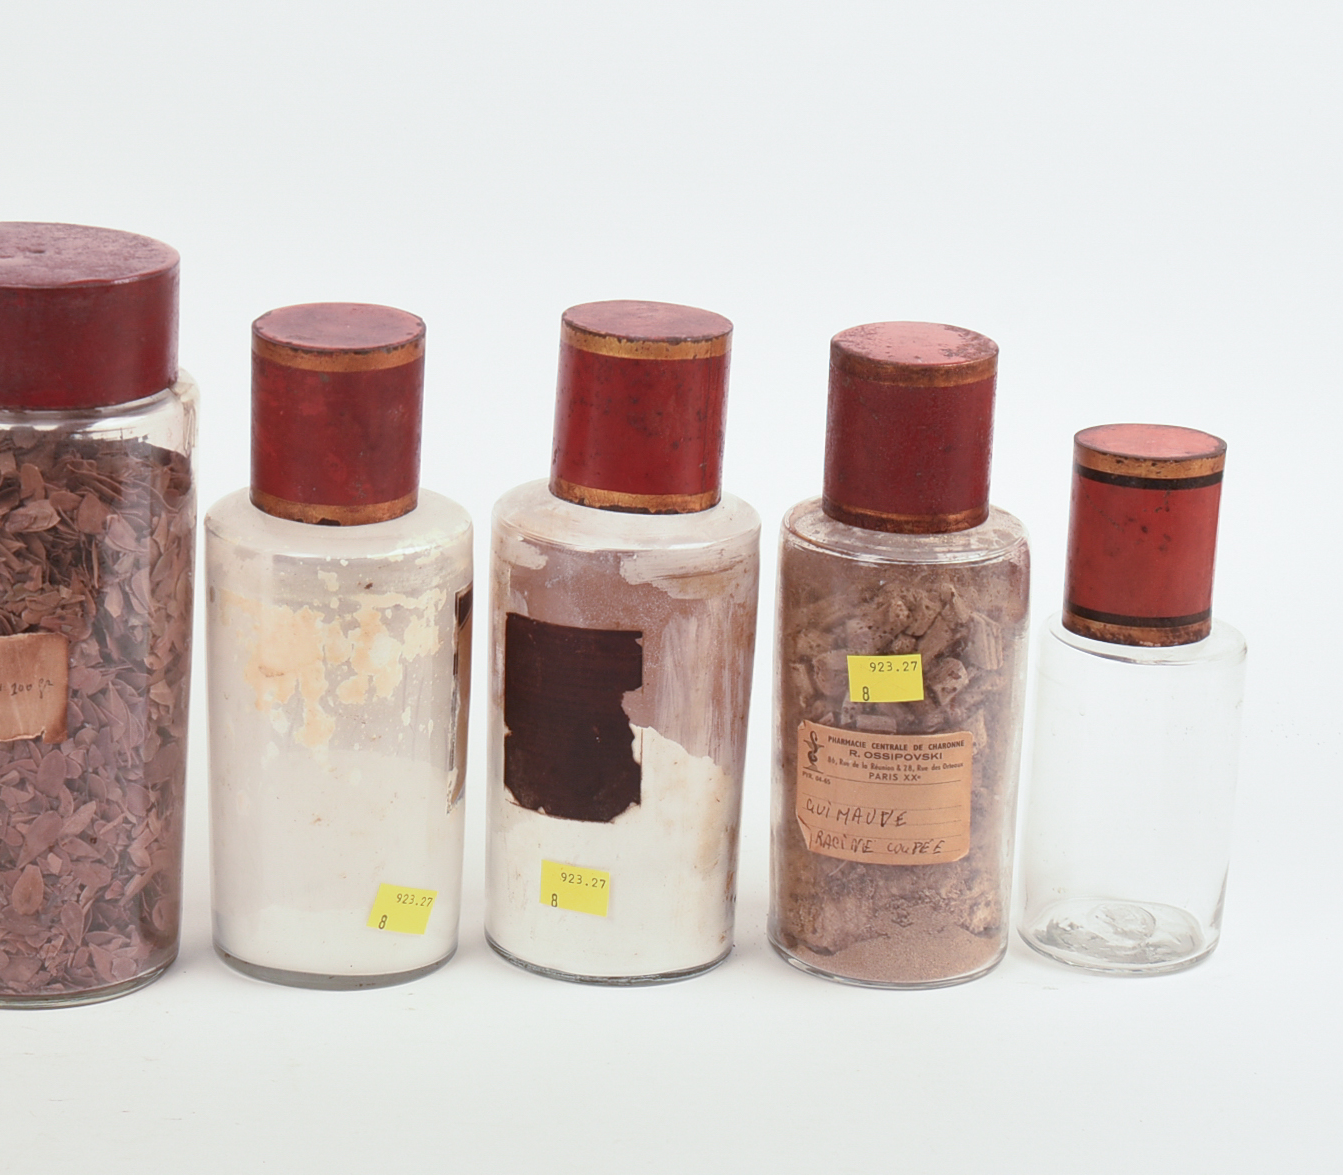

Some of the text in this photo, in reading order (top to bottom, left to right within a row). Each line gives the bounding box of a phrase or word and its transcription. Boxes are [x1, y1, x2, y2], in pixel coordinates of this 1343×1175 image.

[869, 661, 918, 673] 923.27
[862, 685, 870, 702] 8
[827, 735, 965, 751] PHARMACIE CENTRALE DE CHARONNE
[849, 749, 943, 761] R. OSSIPOVSKI
[839, 758, 850, 767] Rue
[852, 760, 859, 769] de
[861, 761, 868, 770] la
[870, 762, 895, 771] Réunion
[896, 764, 902, 772] &
[903, 764, 915, 773] 28,
[917, 763, 928, 772] Rue
[931, 763, 941, 771] des
[942, 761, 964, 770] Orteaux
[868, 772, 899, 781] PARIS
[561, 872, 606, 889] 923.27
[396, 893, 433, 907] 923.27
[551, 893, 558, 907] 8
[378, 914, 388, 930] 8
